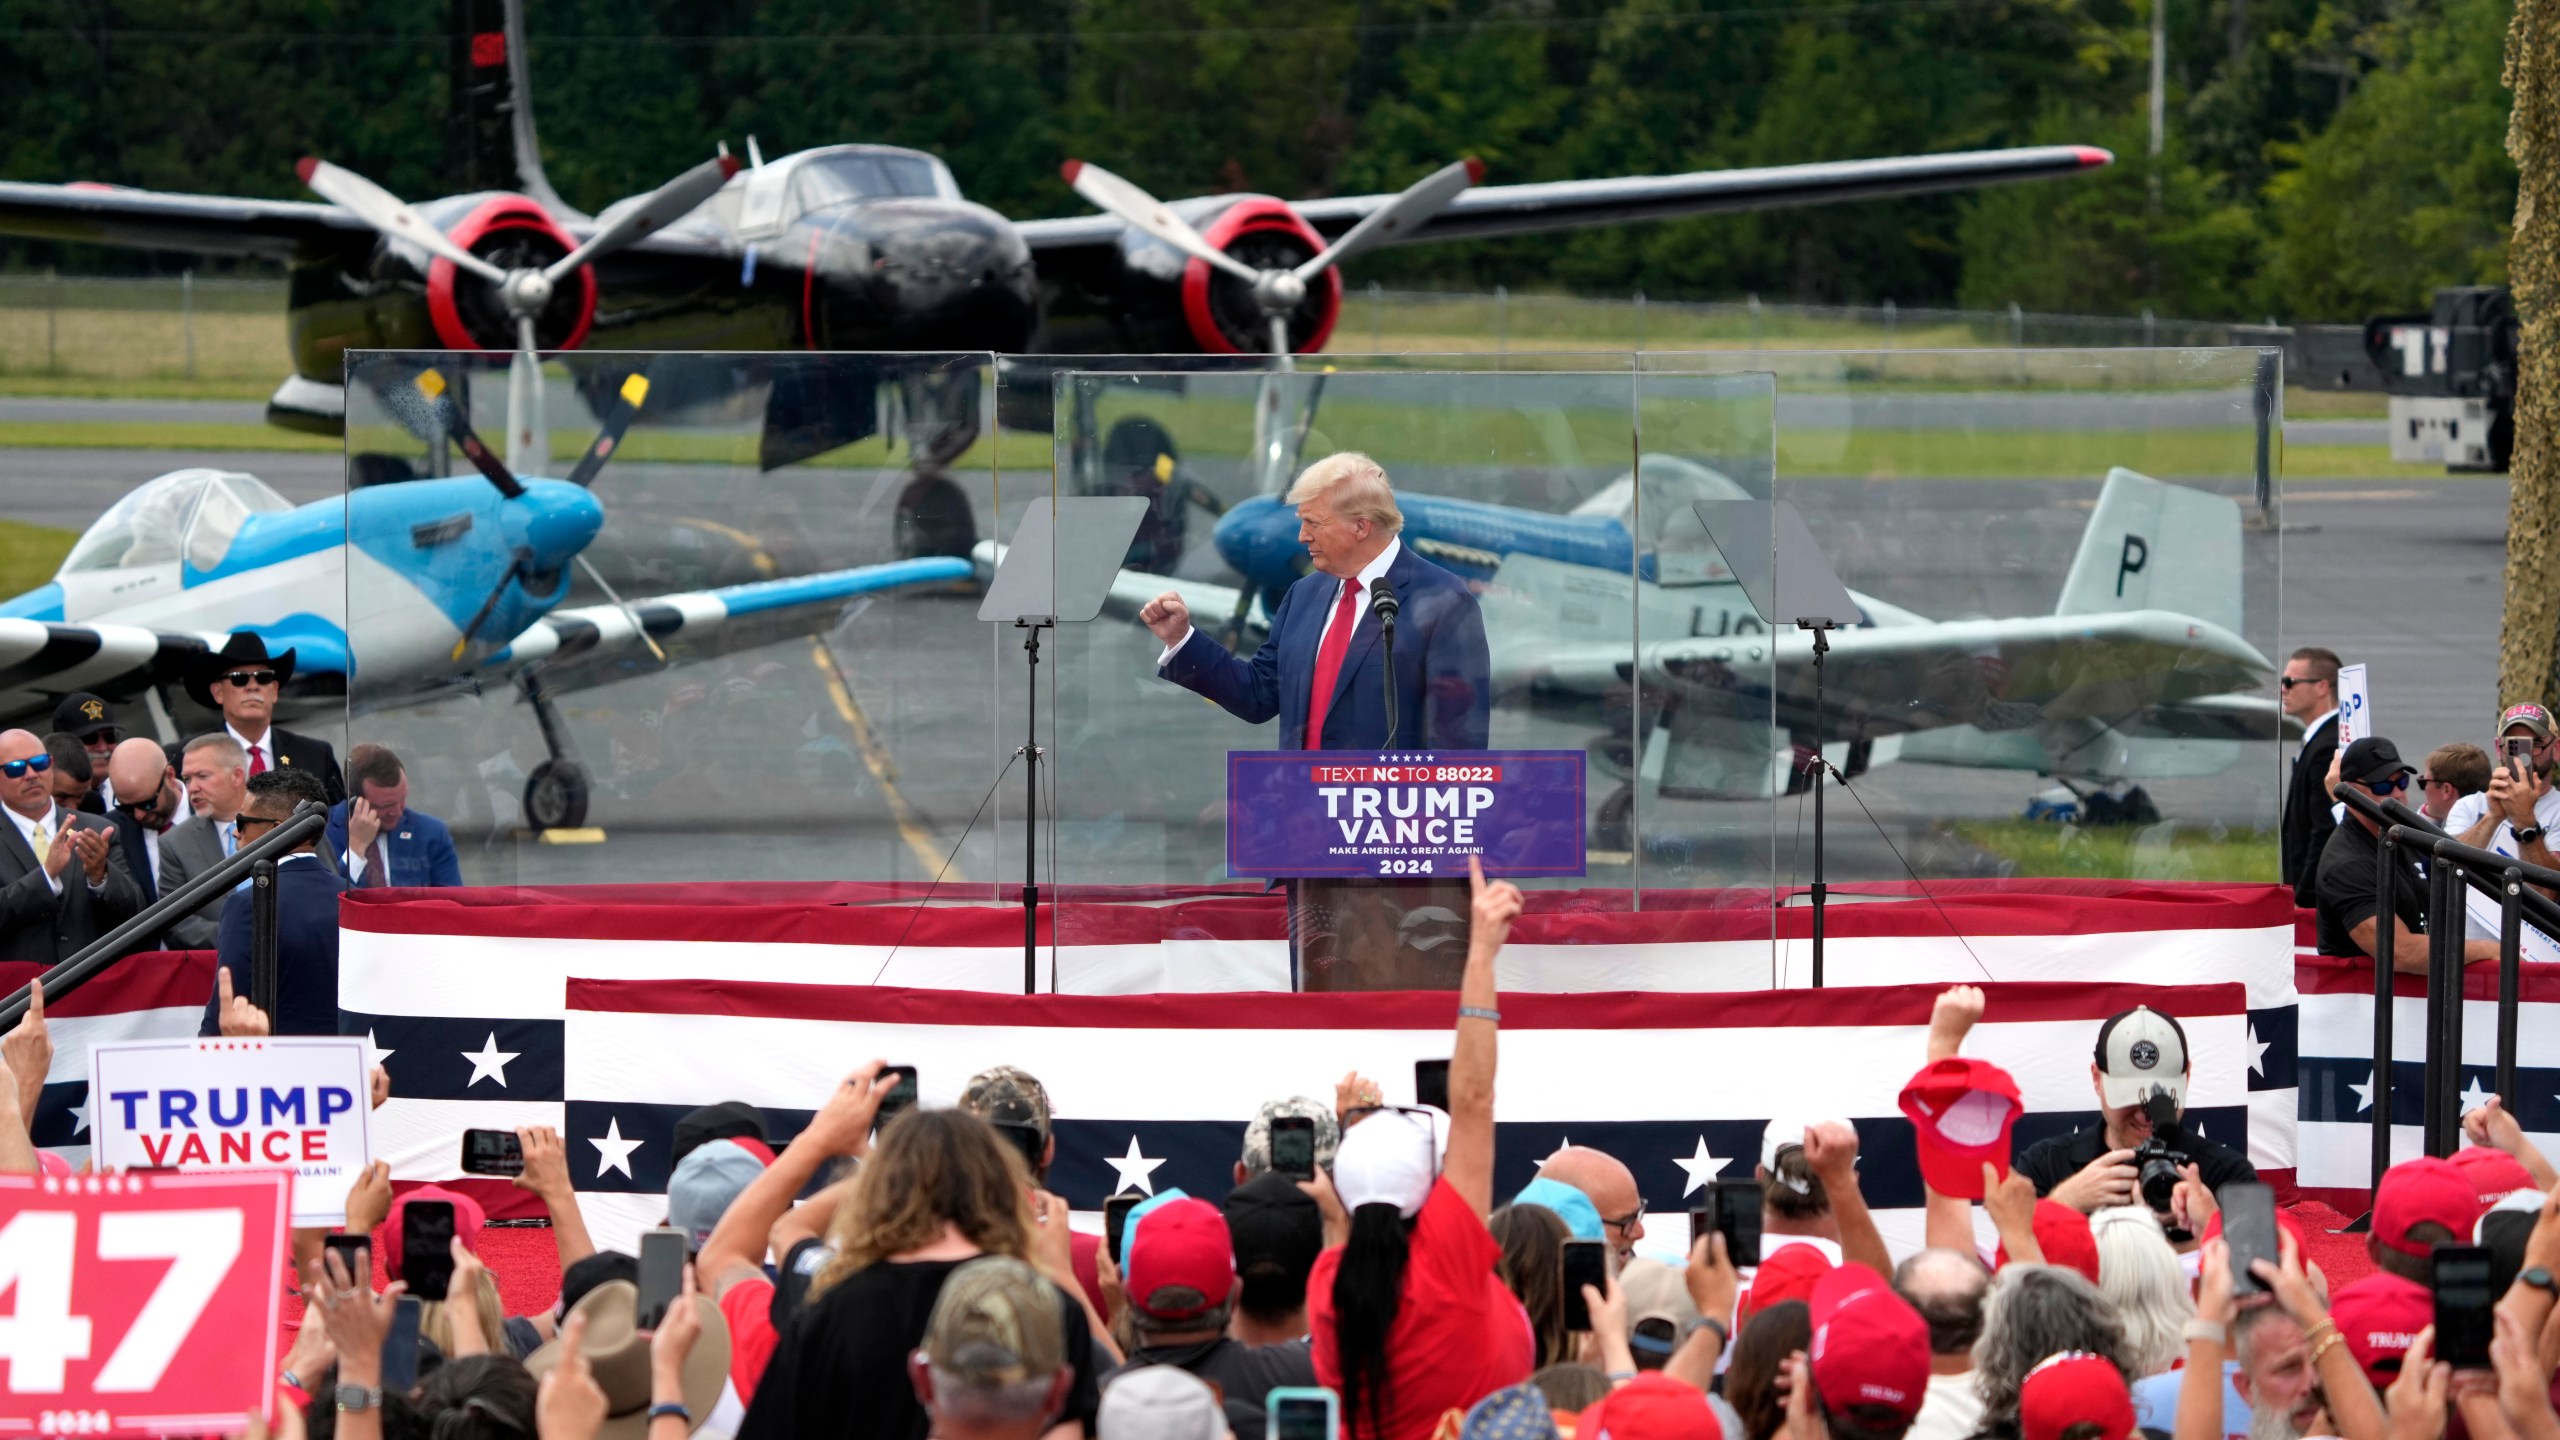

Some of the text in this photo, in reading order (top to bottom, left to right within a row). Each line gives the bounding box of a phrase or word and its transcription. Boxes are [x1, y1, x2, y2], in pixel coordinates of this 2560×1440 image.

[2117, 533, 2148, 598] P
[1320, 767, 1493, 782] TEXT NC TO 88022
[1318, 787, 1495, 818] TRUMP
[1338, 819, 1475, 844] VANCE
[1329, 847, 1484, 855] MAKE AMERICA GREAT AGAIN!
[1379, 859, 1433, 875] 2024
[110, 1087, 353, 1130] TRUMP
[140, 1130, 328, 1165] VANCE
[0, 1207, 245, 1394] 47
[38, 1410, 111, 1434] 2024
